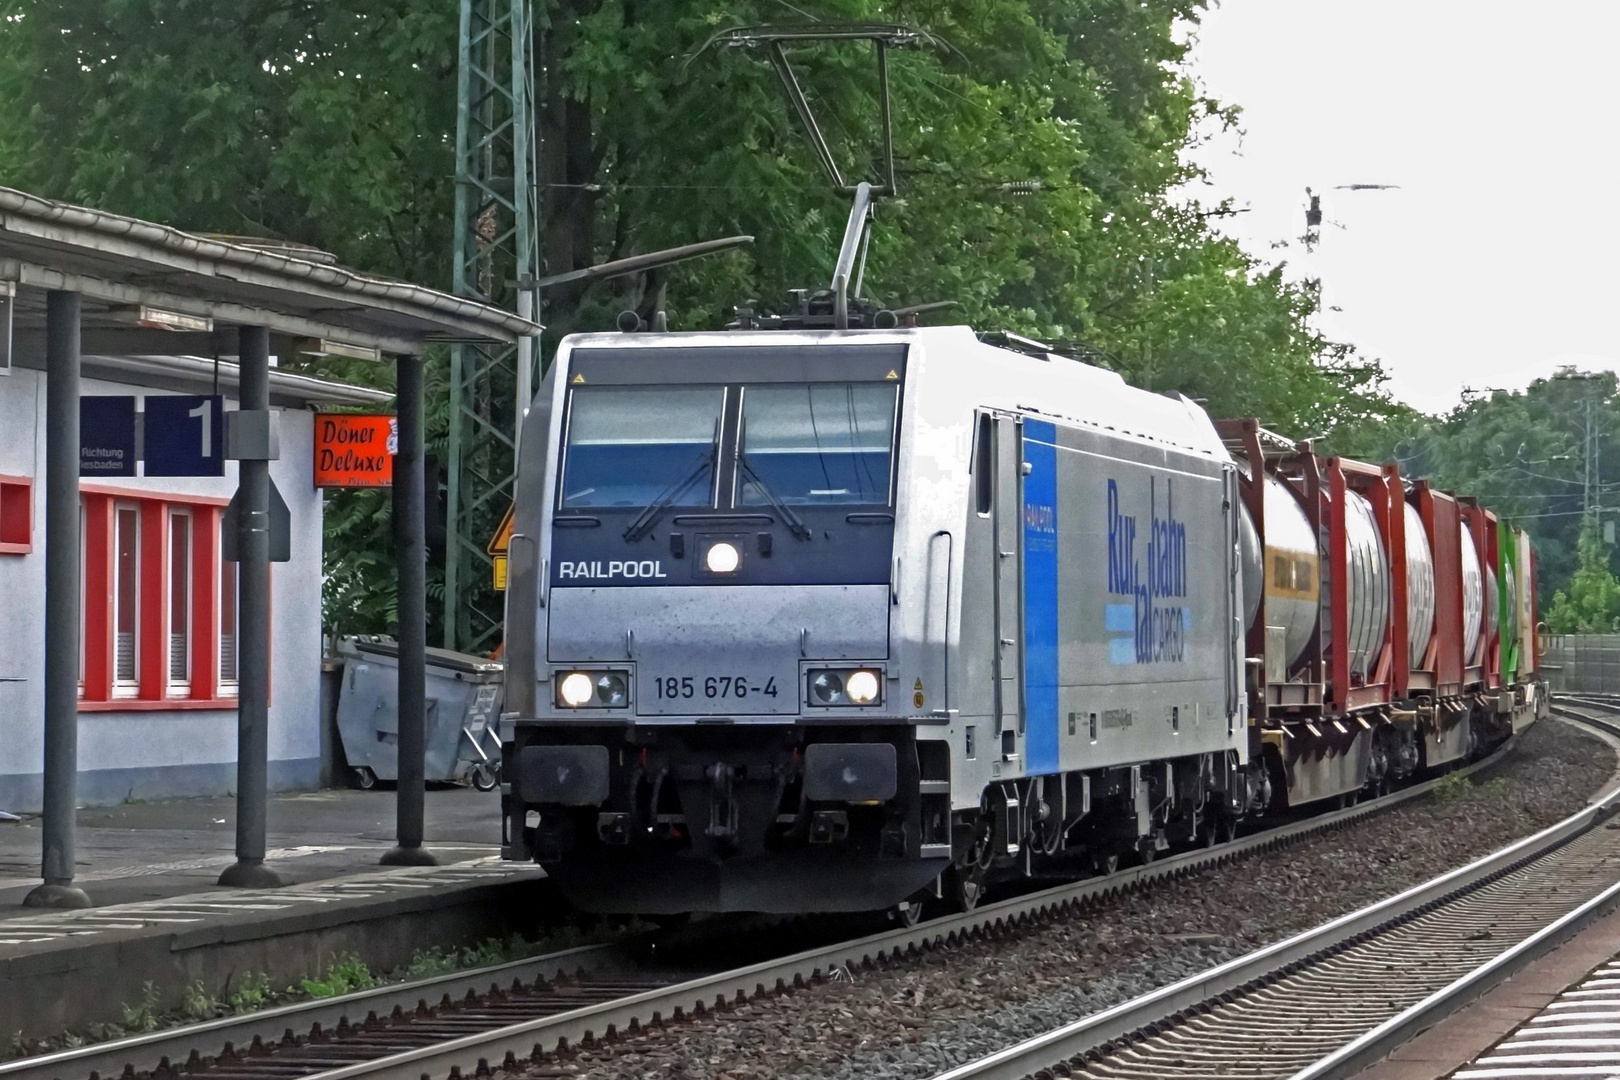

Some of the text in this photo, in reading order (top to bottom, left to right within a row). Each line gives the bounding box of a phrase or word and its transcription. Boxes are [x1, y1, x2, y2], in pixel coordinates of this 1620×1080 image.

[188, 400, 212, 458] 1
[322, 420, 375, 444] Döner
[80, 460, 124, 469] iesbaden
[81, 447, 124, 459] Richtung
[320, 449, 385, 472] Deluxe
[559, 560, 667, 579] RAILPOOL
[1152, 606, 1185, 664] CARGO
[655, 675, 779, 699] 185 676-4
